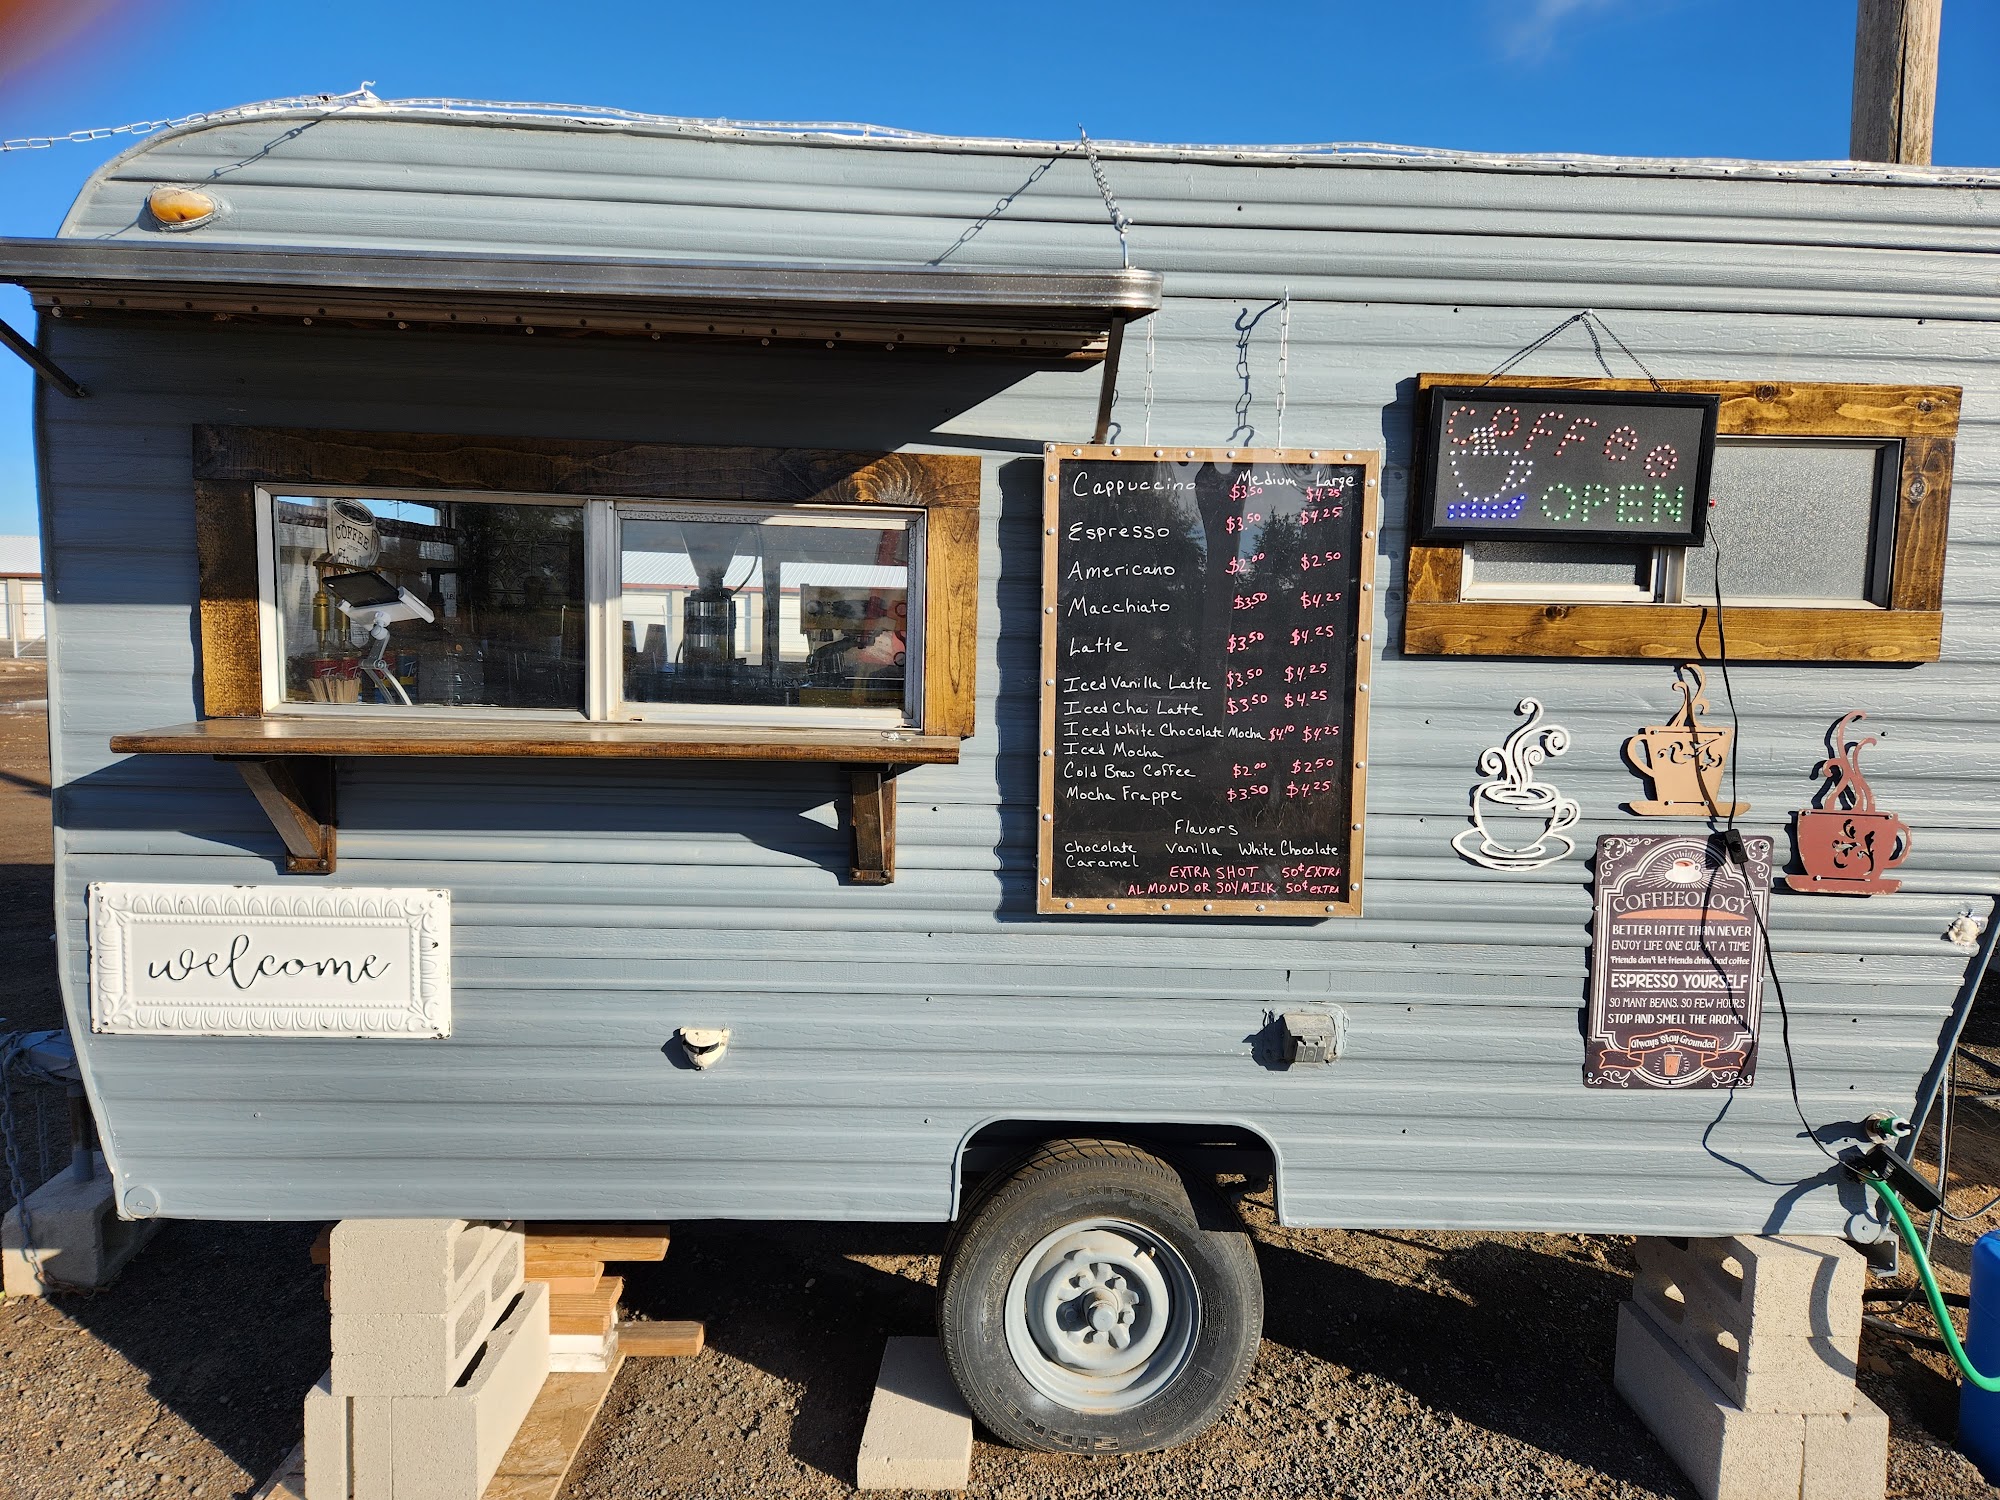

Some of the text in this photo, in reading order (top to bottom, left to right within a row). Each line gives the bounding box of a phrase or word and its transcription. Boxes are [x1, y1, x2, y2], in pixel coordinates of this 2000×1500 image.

[1072, 471, 1341, 502] Cappuccino $3.50 $4.25
[1236, 470, 1355, 491] Medium Large
[1541, 483, 1685, 522] OPEN
[1067, 506, 1343, 541] Espresso $3.50 $4.25
[335, 522, 370, 551] COFFEE
[1067, 551, 1342, 581] Americano $2.00 $2.50
[1067, 591, 1342, 617] Macchiato $3.50 $4.25
[1068, 625, 1334, 657] Latte $3.50 $4.25
[1063, 663, 1328, 693] Iced Vanilla Latte $3.50 $4.25
[1063, 690, 1328, 716] Iced Chai Latte $3.50 $4.25
[1063, 721, 1110, 737] Iced
[1115, 724, 1155, 737] White
[1159, 723, 1225, 739] Chocolate
[1227, 727, 1266, 741] Mocha
[1302, 725, 1340, 743] $4.25
[1063, 742, 1164, 758] Iced Mocha
[1063, 758, 1334, 779] Cold Brew Coffee $2.00 $2.50
[1066, 781, 1331, 806] Mocha Frappe $3.50 $4.25
[1174, 819, 1239, 836] Flavors
[1064, 839, 1339, 857] Chocolate Vanilla White Chocolate
[1066, 854, 1140, 869] Caramel
[1169, 865, 1211, 879] EXTRA
[1216, 865, 1259, 879] SHOT
[1128, 882, 1190, 896] ALMOND
[1194, 884, 1211, 894] OR
[1612, 890, 1752, 915] COFFEEOLOGY
[1612, 924, 1752, 937] BETTER LATTE THAN NEVER
[1611, 940, 1750, 952] ENJOY LIFE ONE CUP AT A TIME
[148, 934, 392, 991] welcome
[1610, 956, 1638, 965] Friends
[1638, 956, 1657, 964] don't
[1657, 956, 1667, 964] let
[1668, 956, 1693, 965] friends
[1728, 957, 1750, 965] coffee
[1610, 973, 1749, 989] ESPRESSO YOURSELF
[1608, 997, 1621, 1008] SO
[1622, 997, 1648, 1008] MANY
[1680, 998, 1692, 1008] SO
[1693, 998, 1715, 1009] FEW
[1716, 999, 1746, 1009] HOURS
[1607, 1013, 1744, 1025] STOP AND SMELL THE AROMA
[1660, 1034, 1680, 1045] Stay
[1680, 1034, 1717, 1049] Grounded
